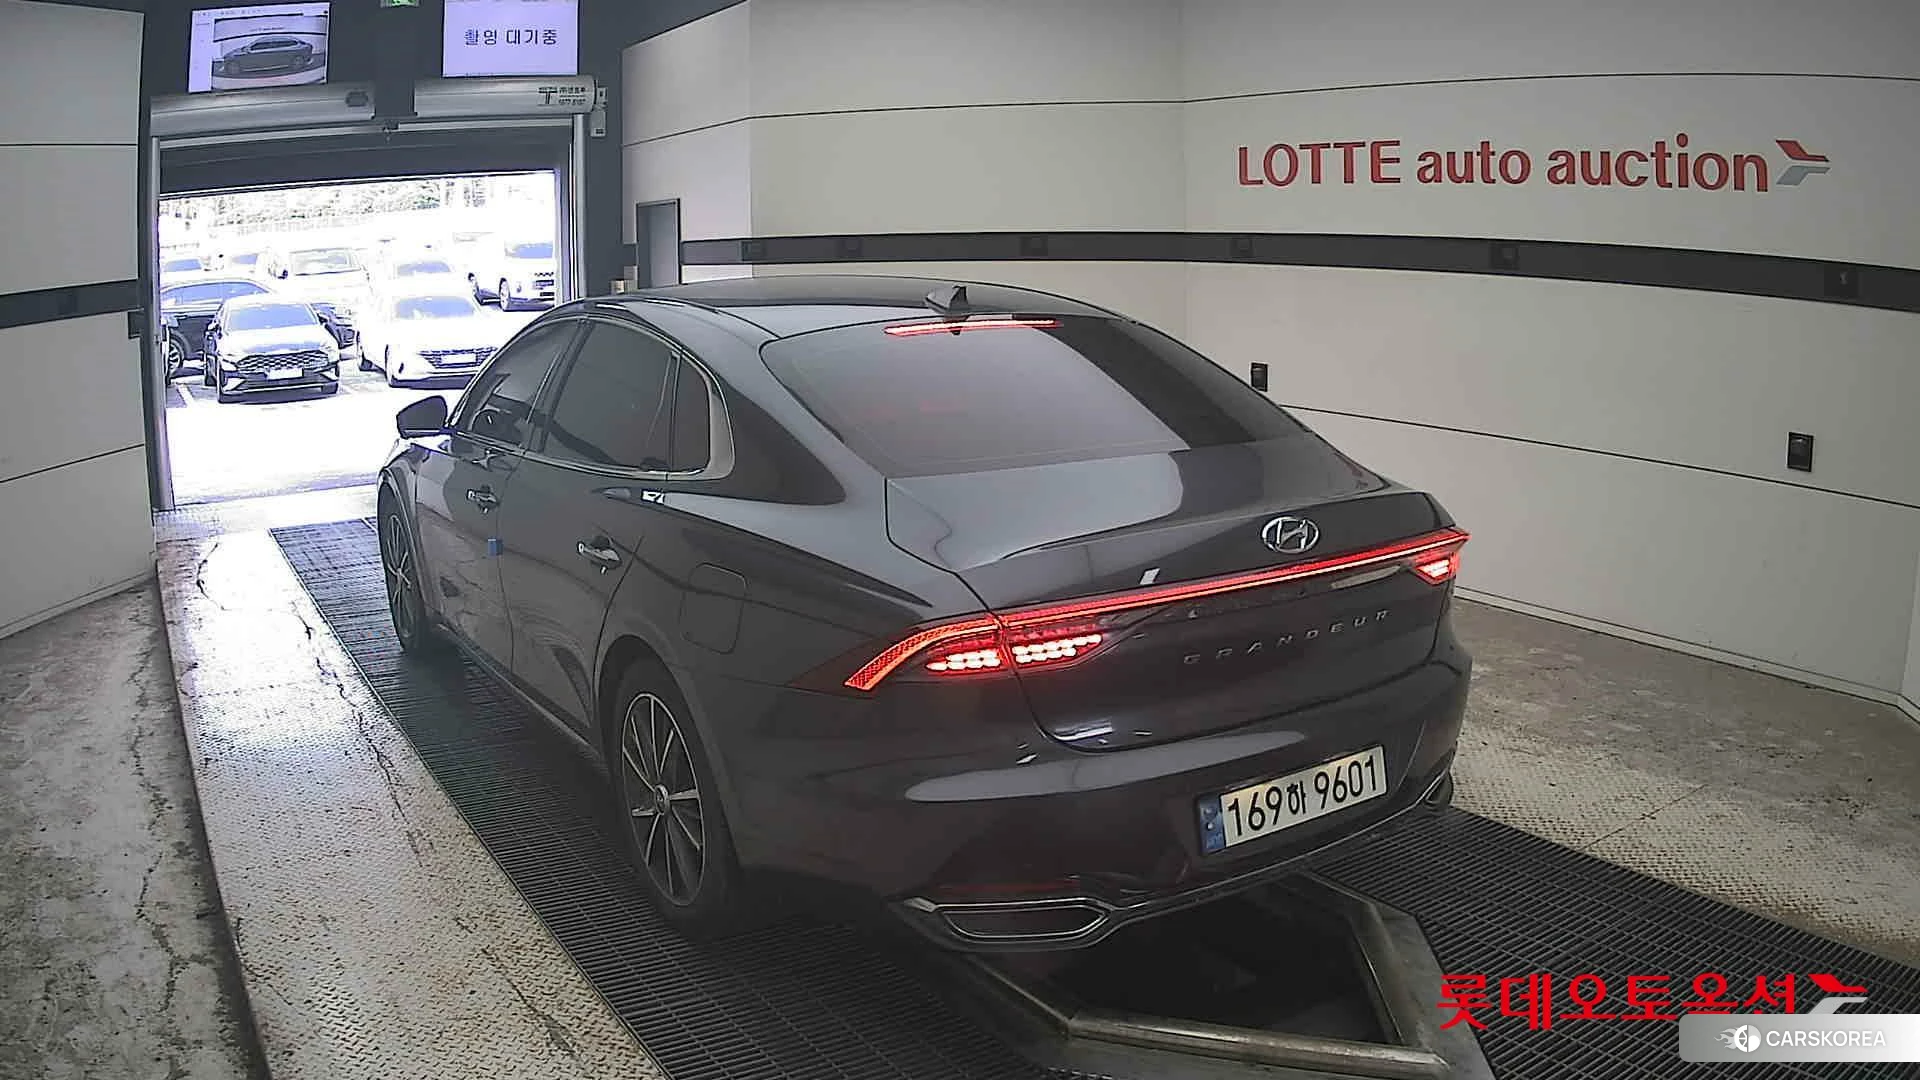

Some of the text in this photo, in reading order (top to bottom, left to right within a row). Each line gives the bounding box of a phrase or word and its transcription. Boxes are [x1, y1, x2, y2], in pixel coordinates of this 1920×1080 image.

[506, 29, 557, 45] 대기중
[1238, 132, 1769, 192] LOTTE auto auction
[1228, 755, 1376, 836] 169하 9601
